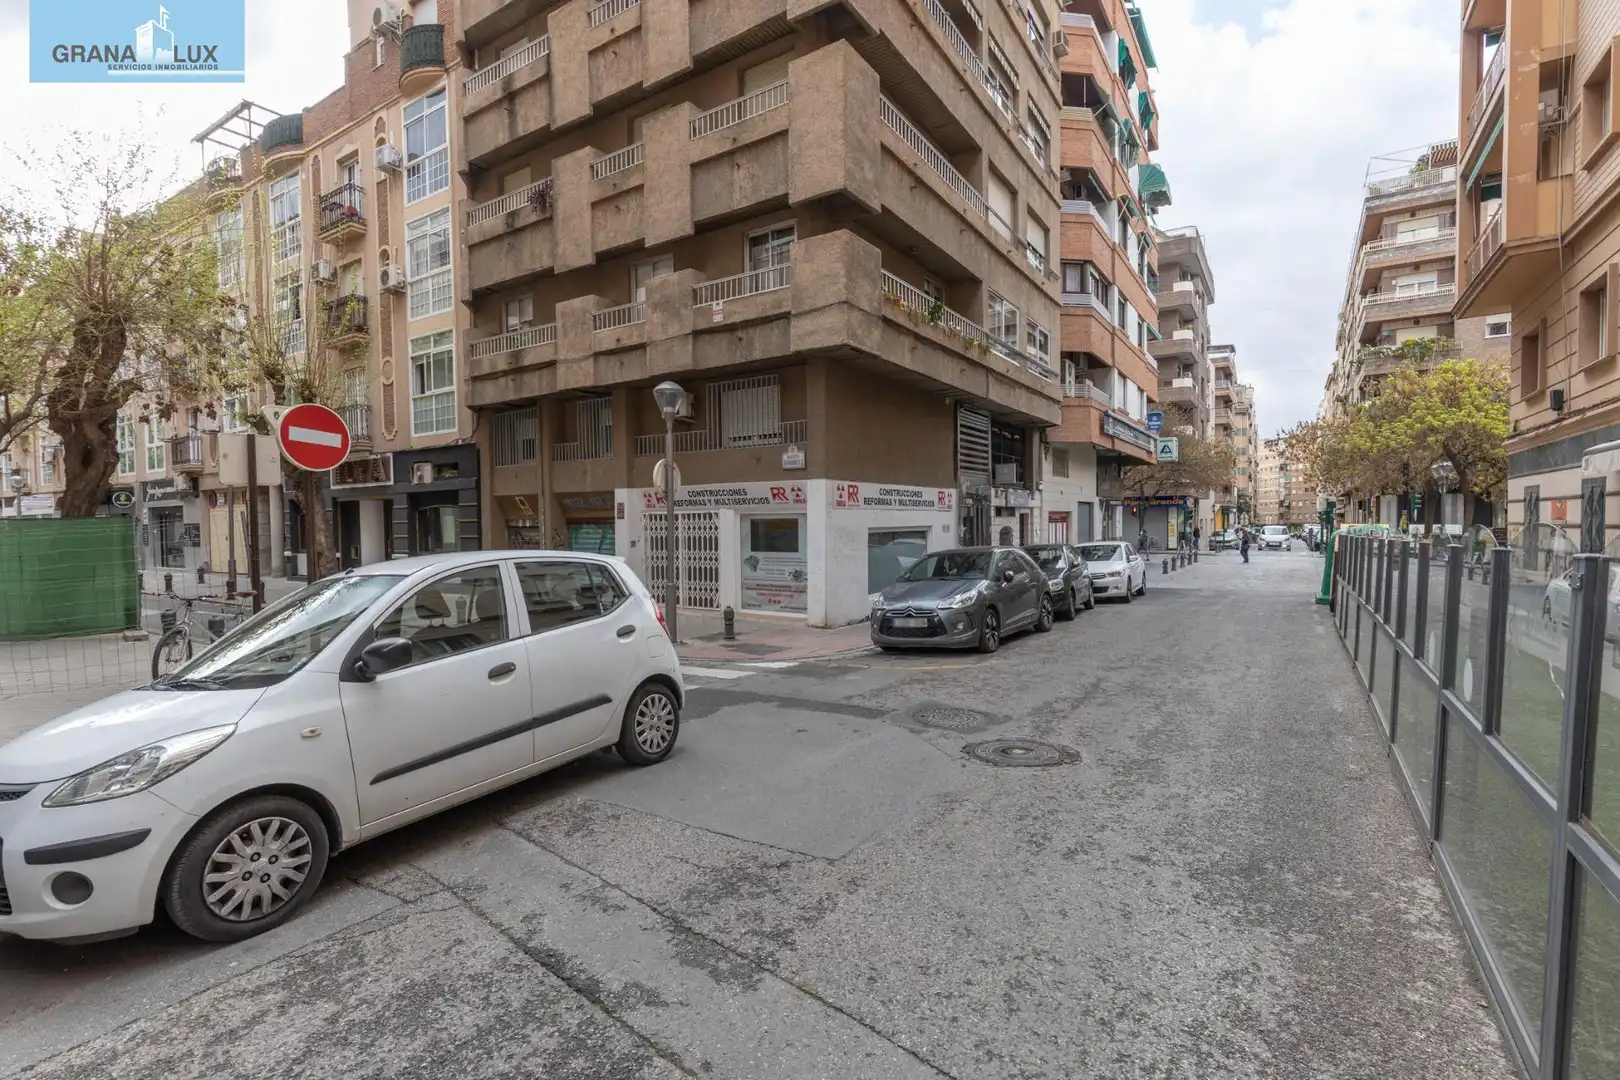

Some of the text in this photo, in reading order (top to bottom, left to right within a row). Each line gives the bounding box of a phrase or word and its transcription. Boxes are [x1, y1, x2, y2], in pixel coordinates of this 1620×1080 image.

[687, 488, 748, 498] CONSTRUCCIONES
[879, 488, 923, 498] CONSTRUCCIONES
[673, 497, 771, 507] REFORMAS Y MULTISERVICIOS
[863, 497, 935, 508] REFORMAS Y MULTISERVICIOS
